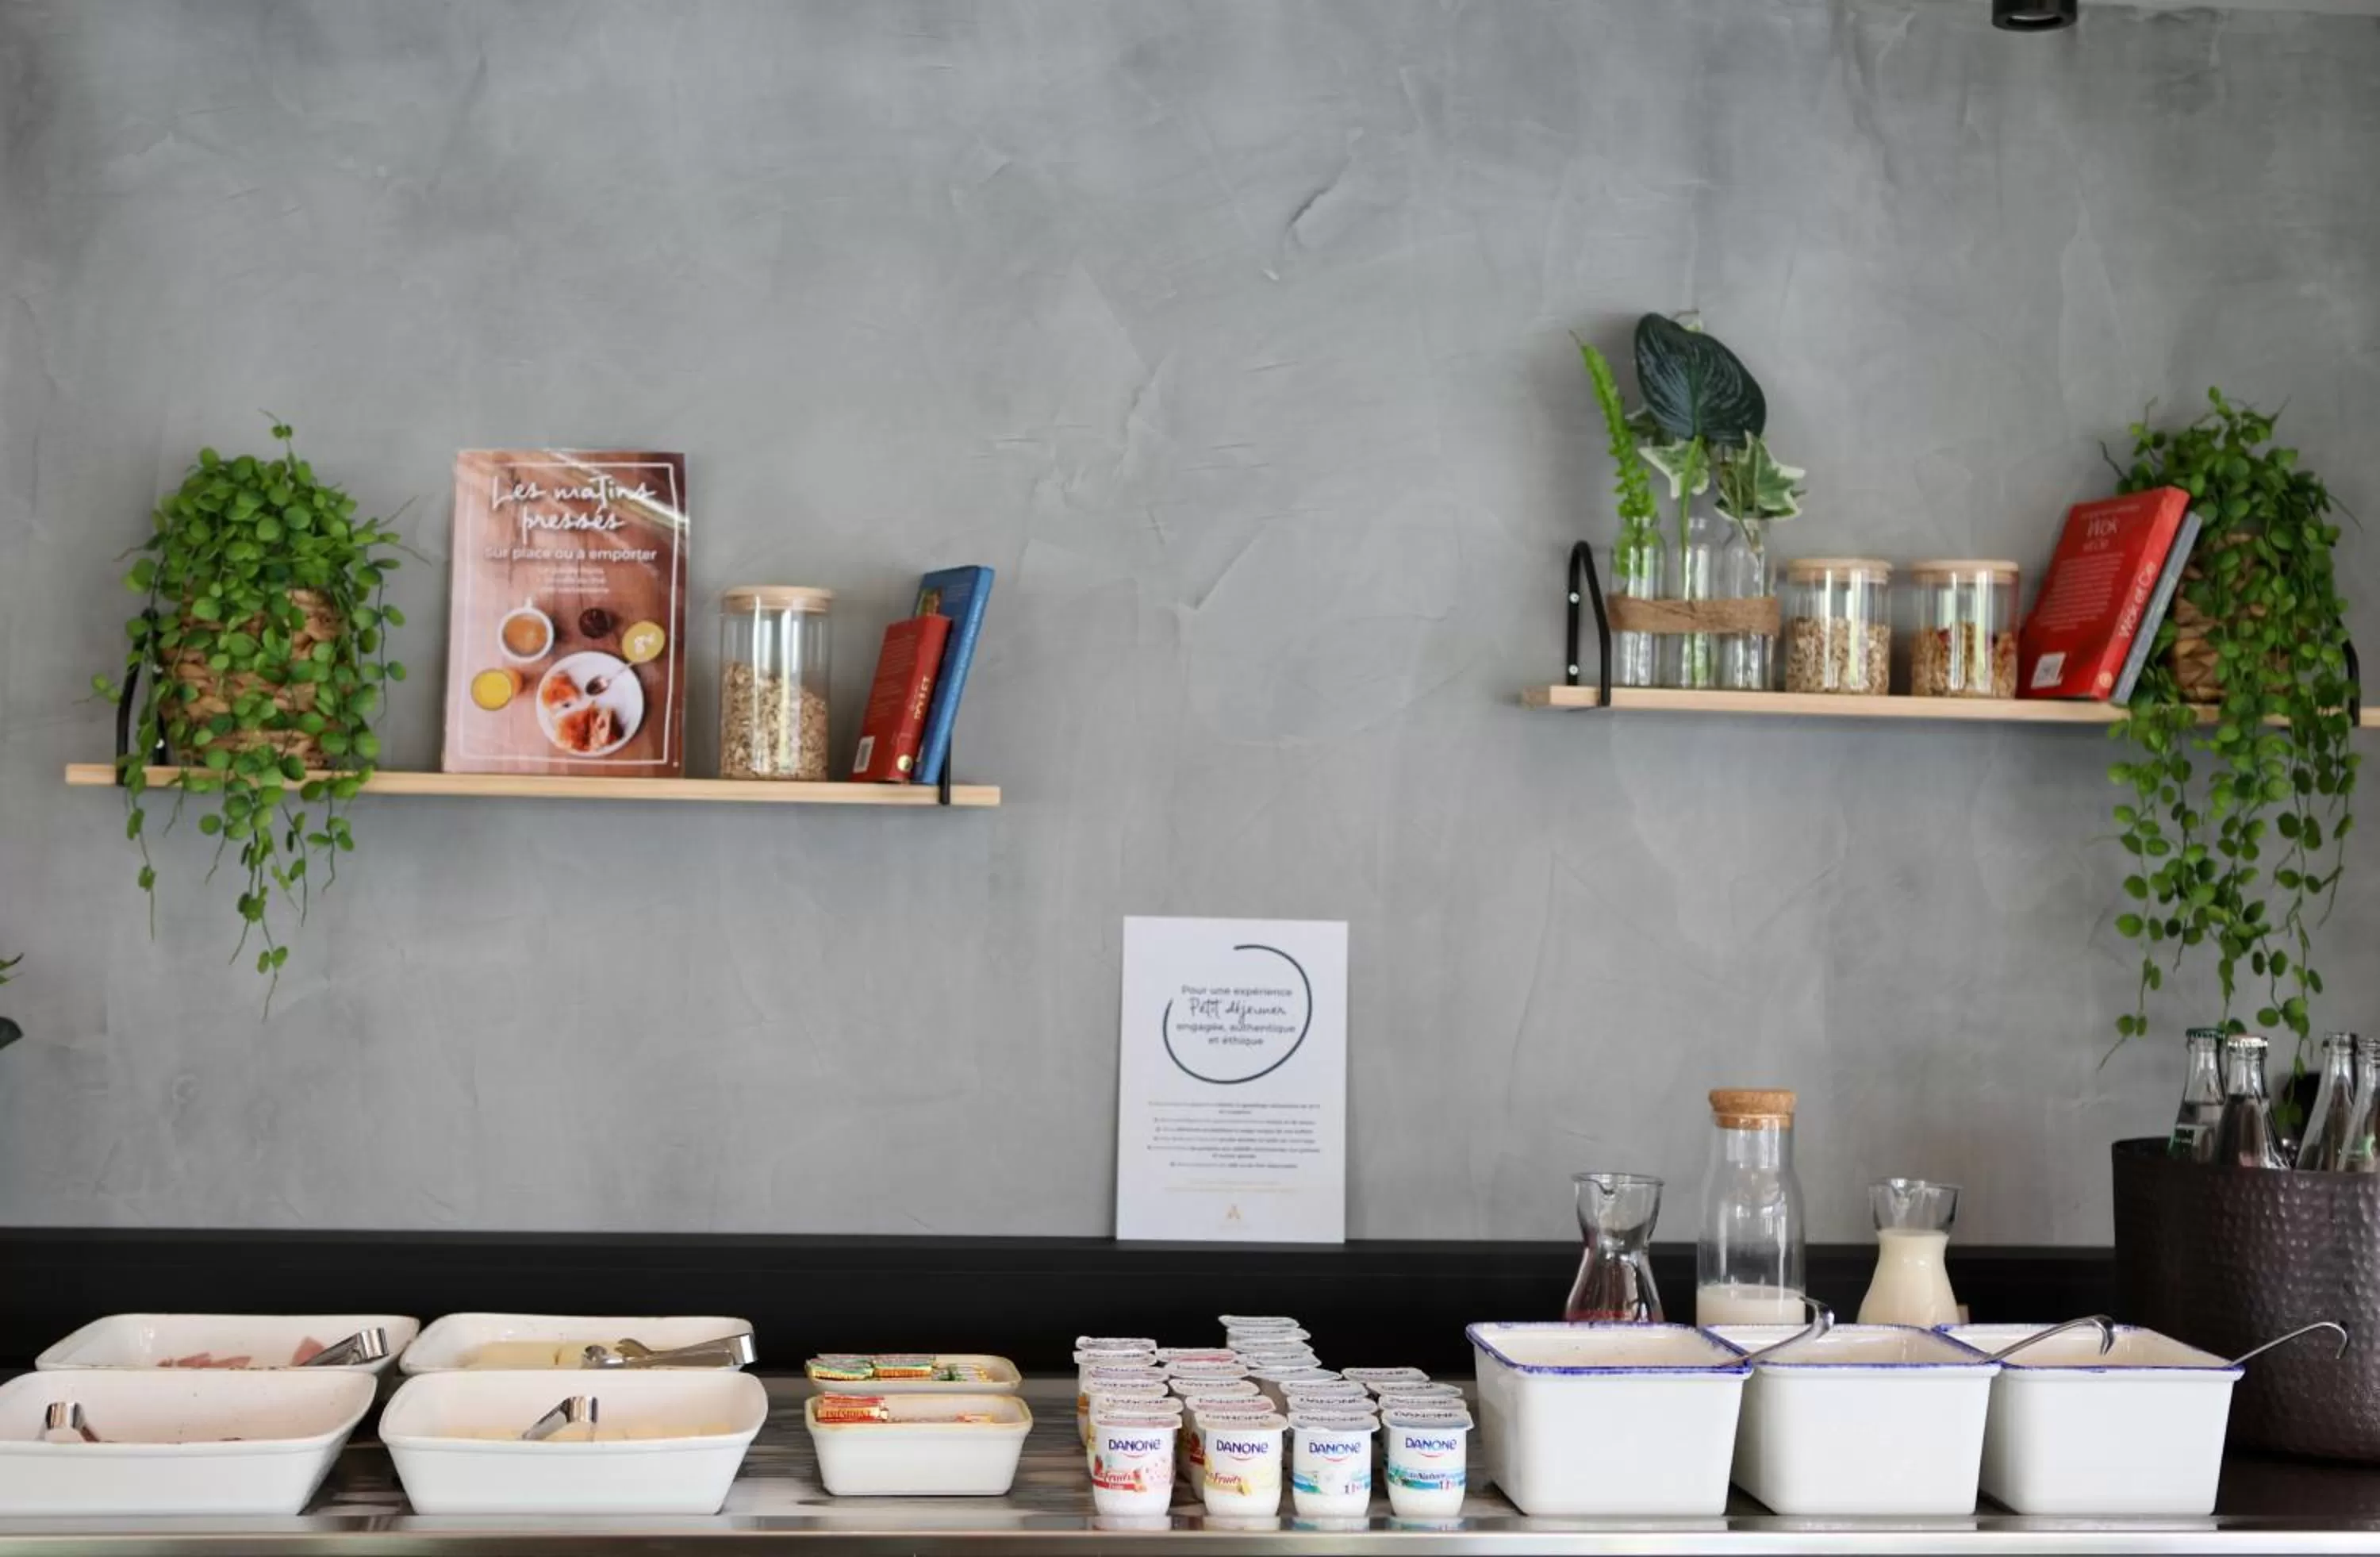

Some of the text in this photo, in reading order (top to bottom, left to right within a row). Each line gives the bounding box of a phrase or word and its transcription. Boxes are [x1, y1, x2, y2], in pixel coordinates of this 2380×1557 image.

[492, 476, 546, 510] Les
[521, 506, 626, 545] pressés
[512, 548, 553, 560] place
[556, 549, 574, 559] ou
[589, 548, 657, 562] emporter
[1181, 984, 1207, 995] Pour
[1209, 986, 1230, 995] une
[1189, 997, 1287, 1027] Petit déjeuner
[1107, 1439, 1162, 1451] DANONE
[1215, 1439, 1269, 1454] DANONE
[1309, 1441, 1361, 1455] DANONE
[1405, 1437, 1457, 1451] DANONE
[1214, 1472, 1242, 1485] Fruits
